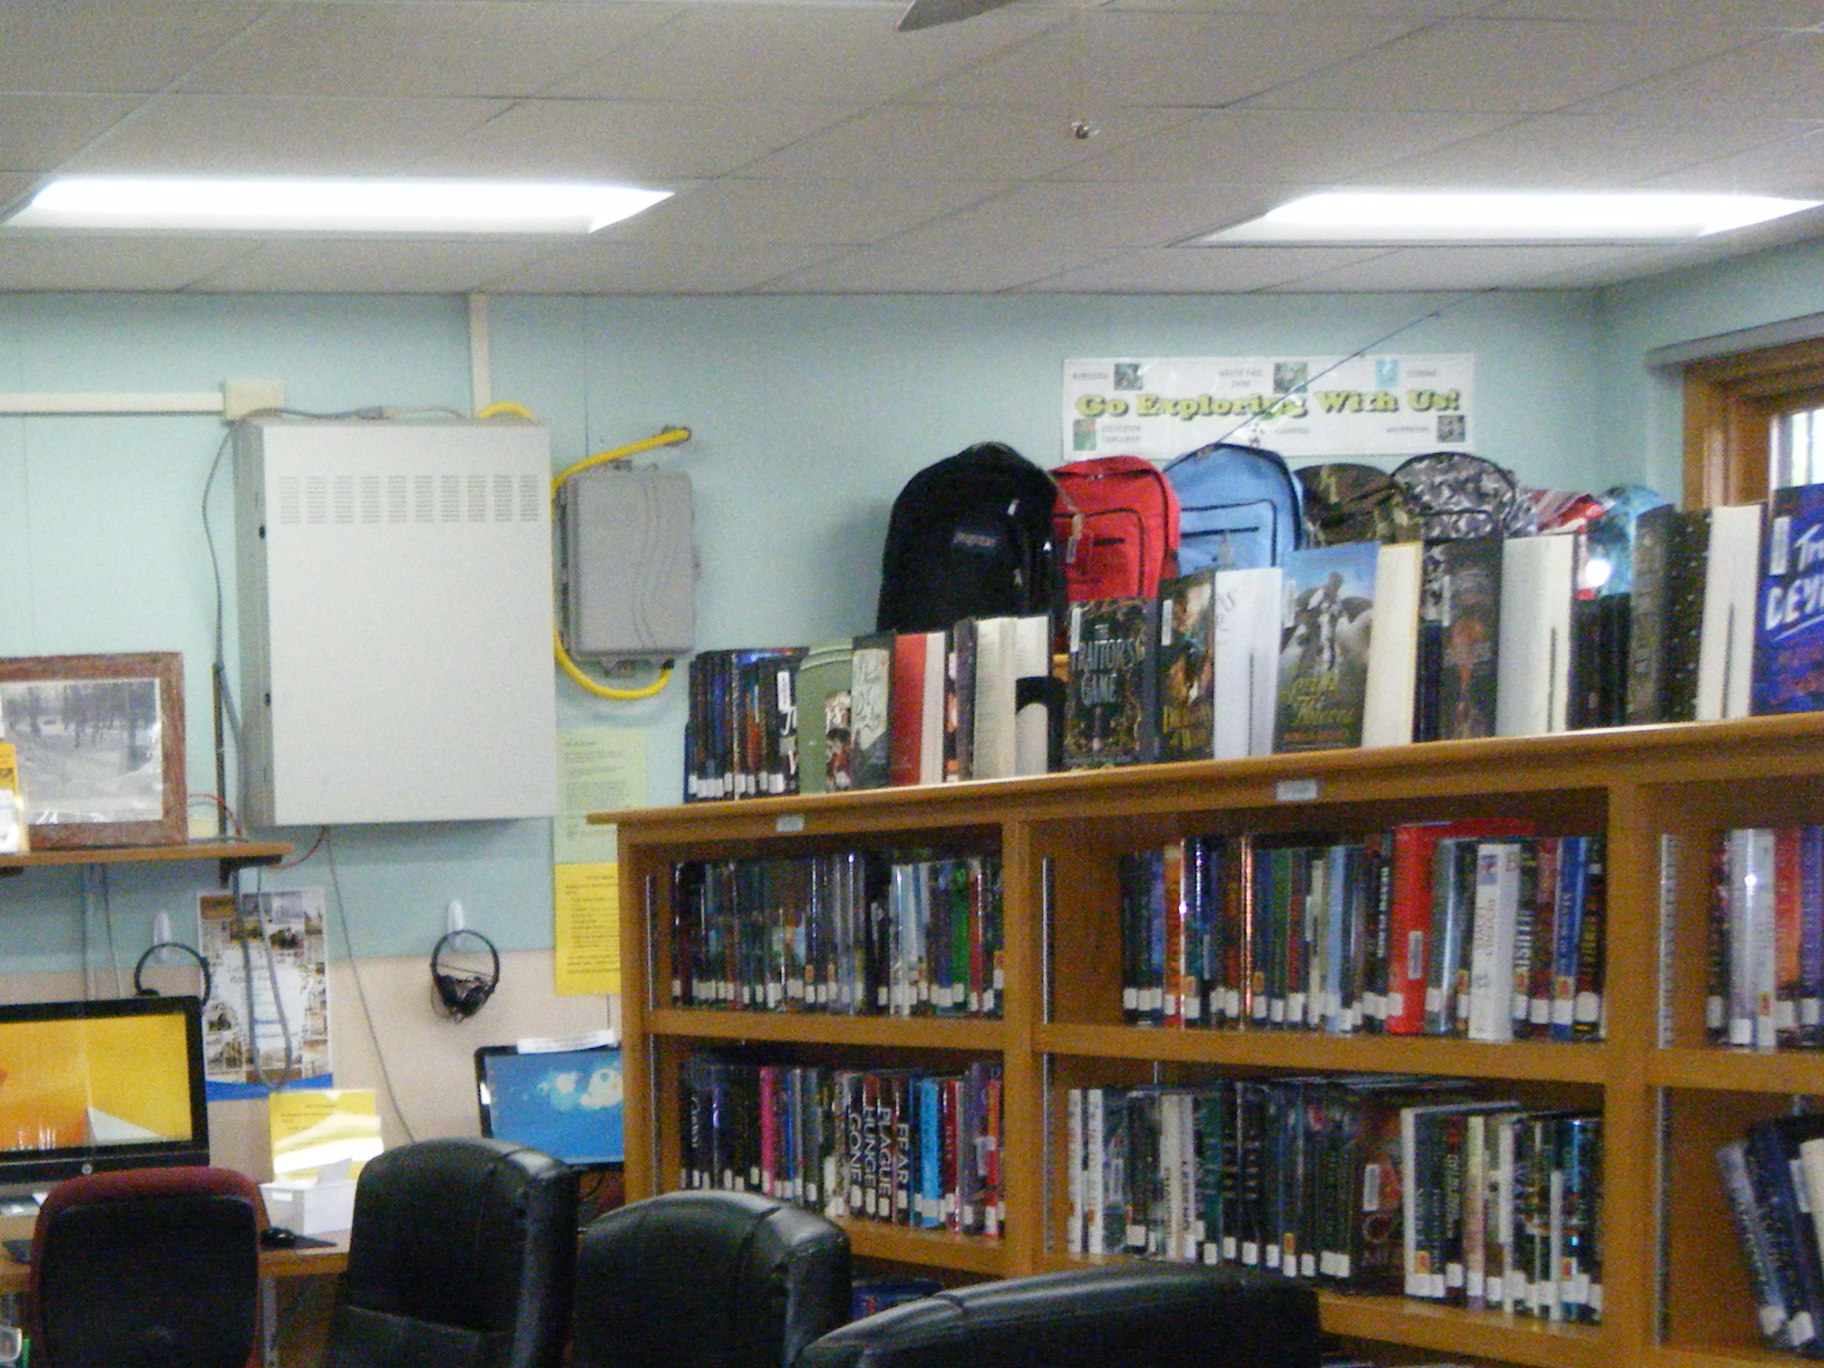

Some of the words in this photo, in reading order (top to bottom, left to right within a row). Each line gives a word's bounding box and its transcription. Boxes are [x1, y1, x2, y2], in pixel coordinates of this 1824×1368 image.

[1075, 394, 1129, 417] Go
[1314, 390, 1398, 414] With
[1407, 388, 1460, 412] Us!
[849, 1113, 862, 1183] GONE
[878, 1108, 893, 1196] PLAGUE
[896, 1124, 910, 1185] FEAR
